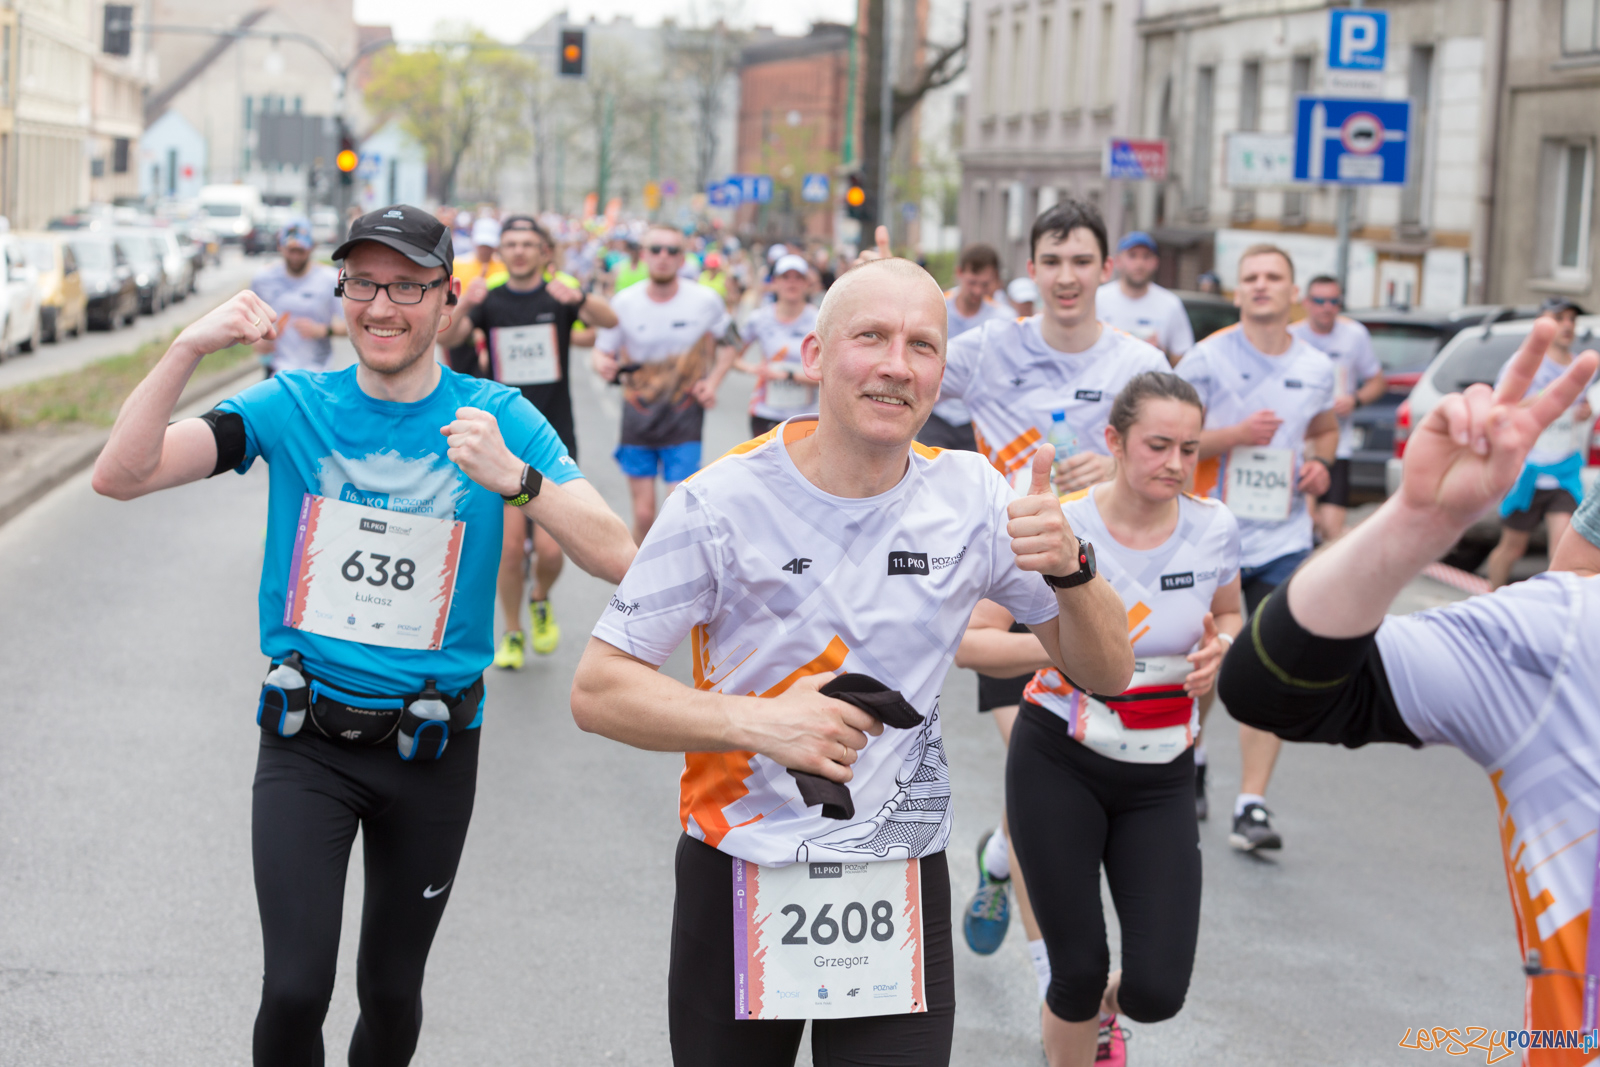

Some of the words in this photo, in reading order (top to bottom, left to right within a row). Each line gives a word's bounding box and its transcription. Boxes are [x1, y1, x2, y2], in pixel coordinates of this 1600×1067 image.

[1339, 15, 1378, 64] P
[1236, 468, 1287, 489] 11204
[393, 505, 434, 513] maraton
[782, 558, 812, 574] 4F
[893, 558, 906, 568] 11.
[908, 557, 925, 569] PKO
[341, 550, 416, 591] 638
[355, 592, 392, 606] Łukasz
[340, 729, 362, 740] 4F
[813, 867, 823, 875] 11.
[823, 866, 840, 874] PKO
[780, 899, 895, 945] 2608
[813, 955, 869, 969] Grzegorz
[847, 988, 861, 997] 4F
